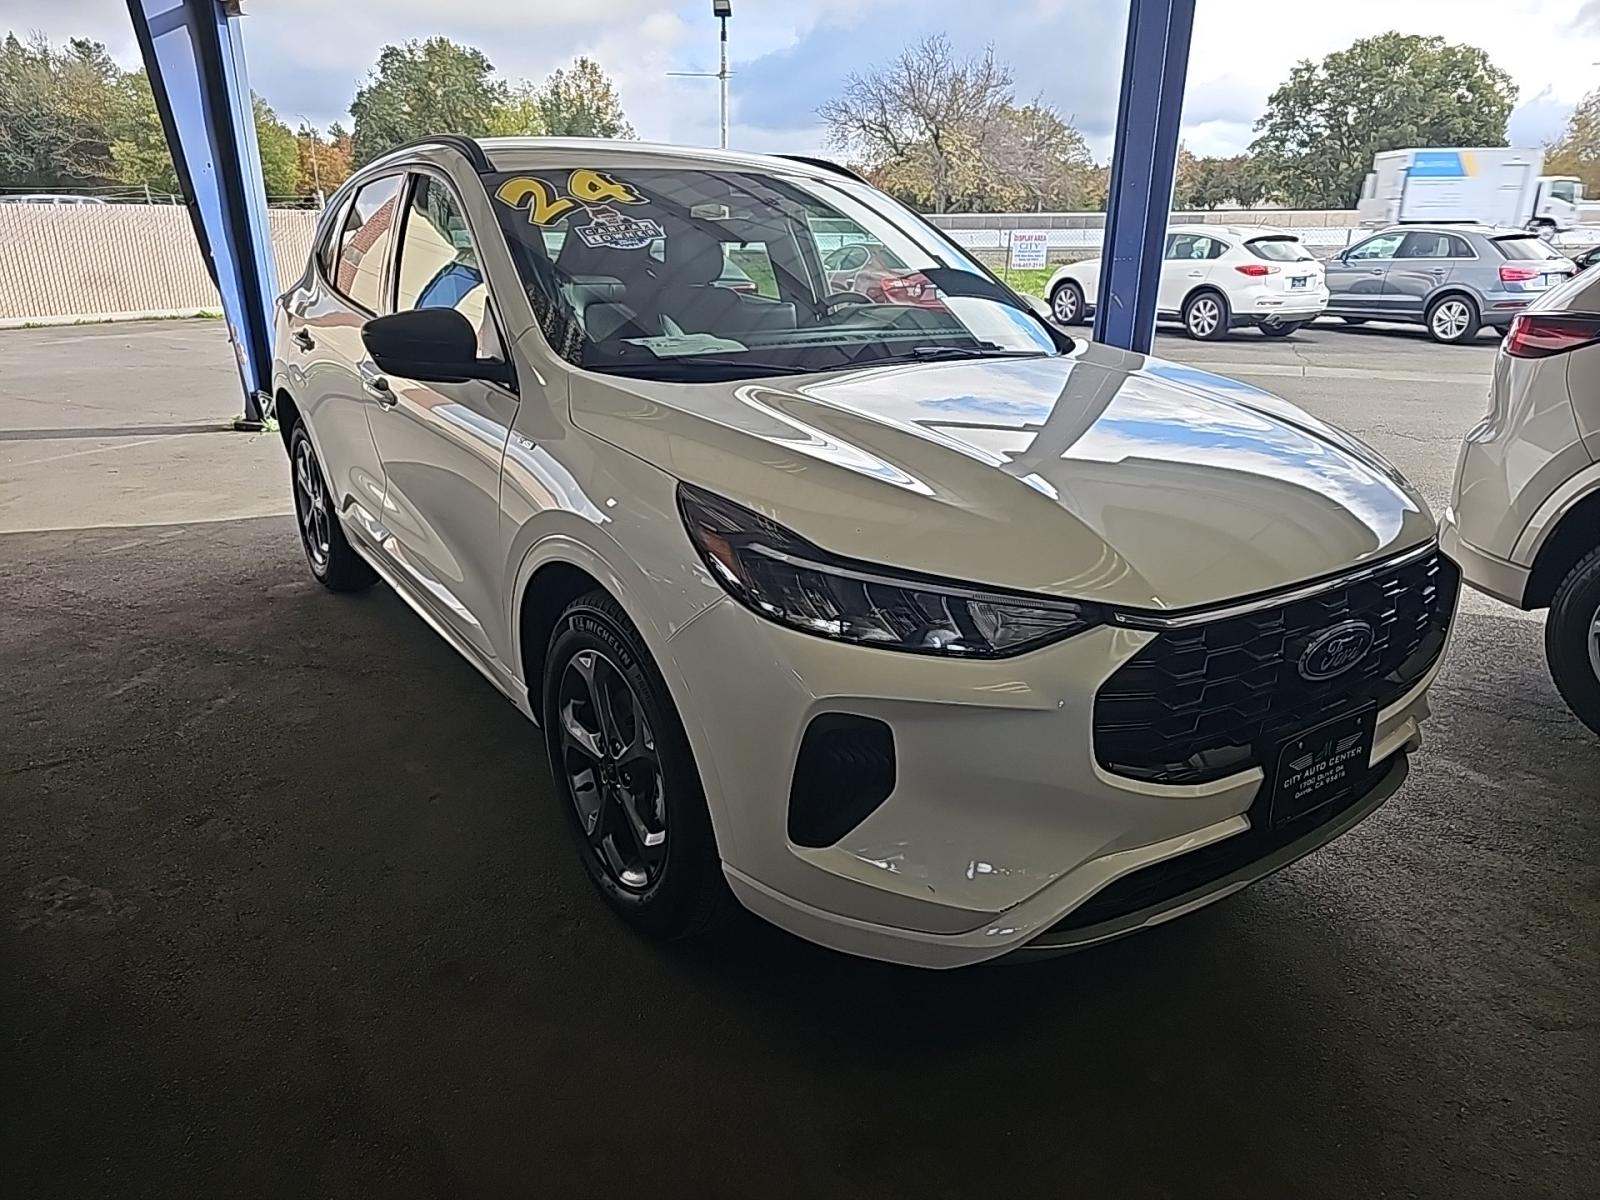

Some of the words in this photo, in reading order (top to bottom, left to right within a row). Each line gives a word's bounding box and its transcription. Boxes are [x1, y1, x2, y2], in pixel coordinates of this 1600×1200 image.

[585, 222, 651, 235] CARFAX
[602, 230, 656, 241] OWNER
[1014, 234, 1033, 242] DISPLAY
[1034, 234, 1047, 242] AREA
[585, 619, 631, 666] MICHELIN
[1320, 636, 1364, 671] Ford
[1283, 772, 1303, 789] CITY
[1303, 761, 1327, 778] AUTO
[1328, 746, 1363, 767] CENTER
